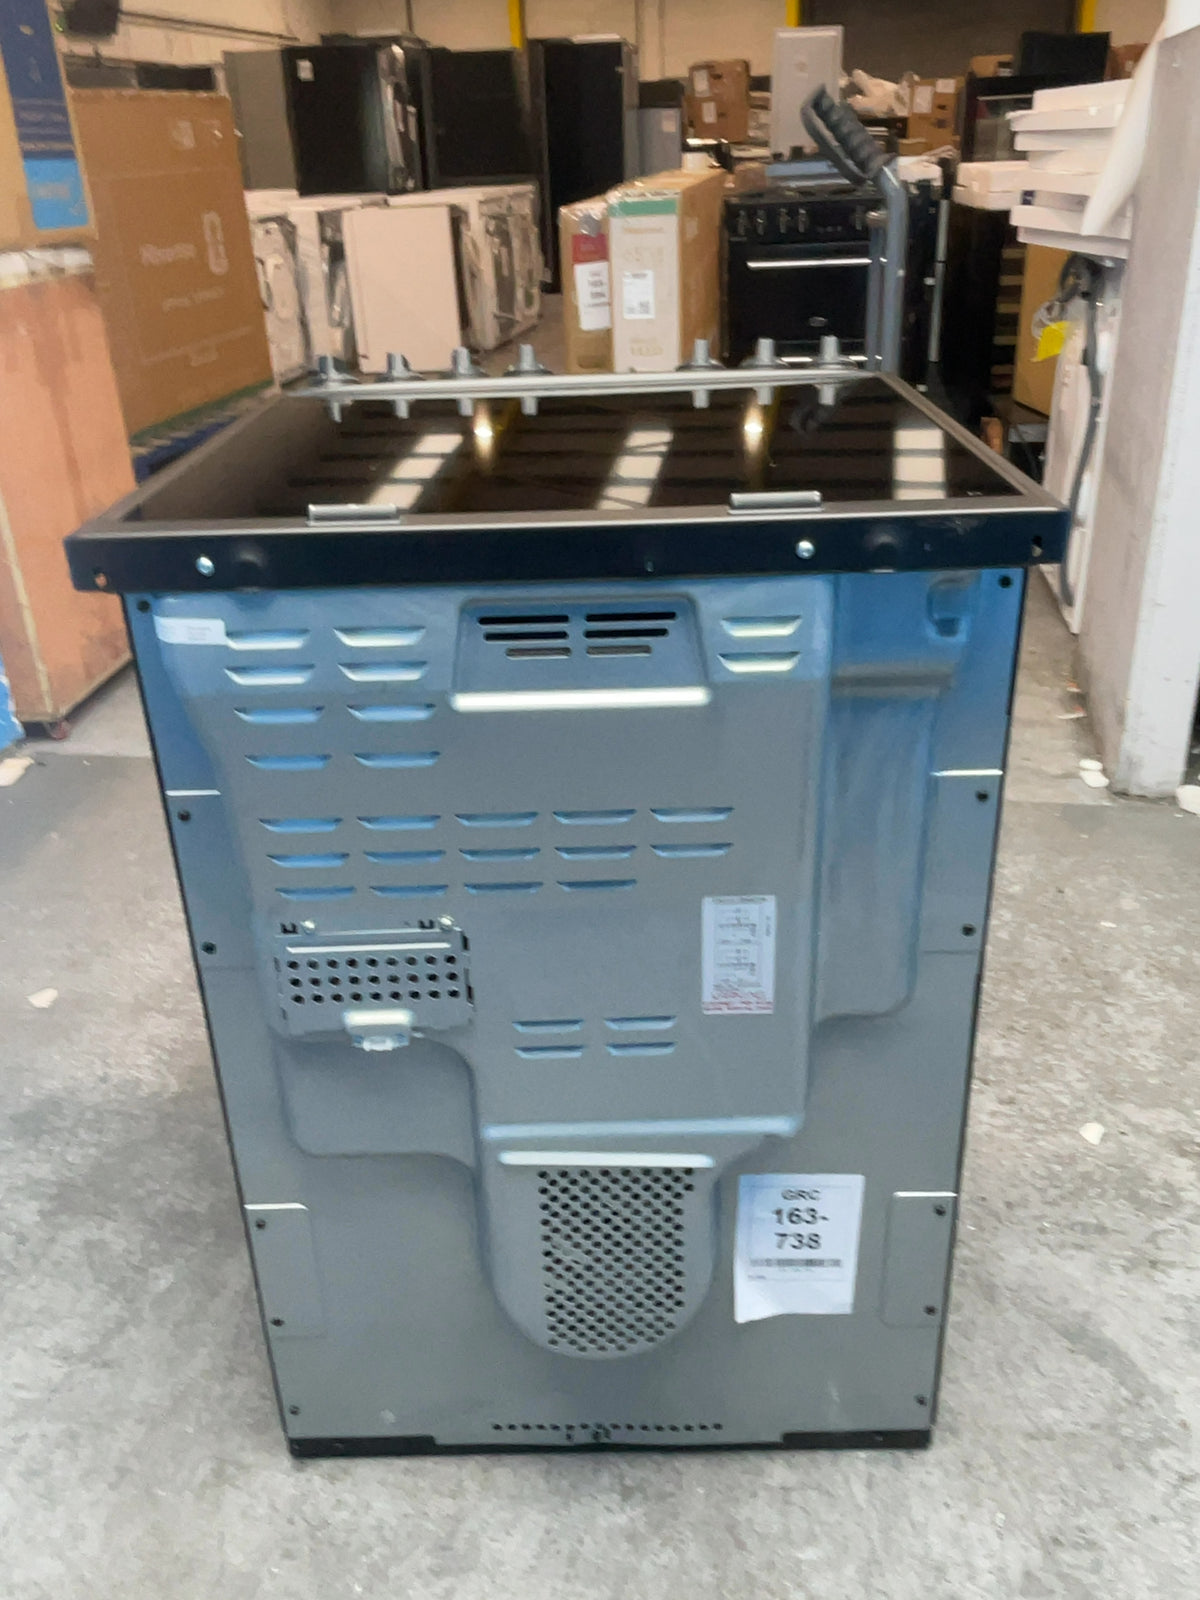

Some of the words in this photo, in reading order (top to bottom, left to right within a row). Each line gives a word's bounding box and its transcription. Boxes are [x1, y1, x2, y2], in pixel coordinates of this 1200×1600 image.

[781, 1189, 821, 1201] GRC
[772, 1207, 829, 1225] 163-
[775, 1232, 822, 1250] 738
